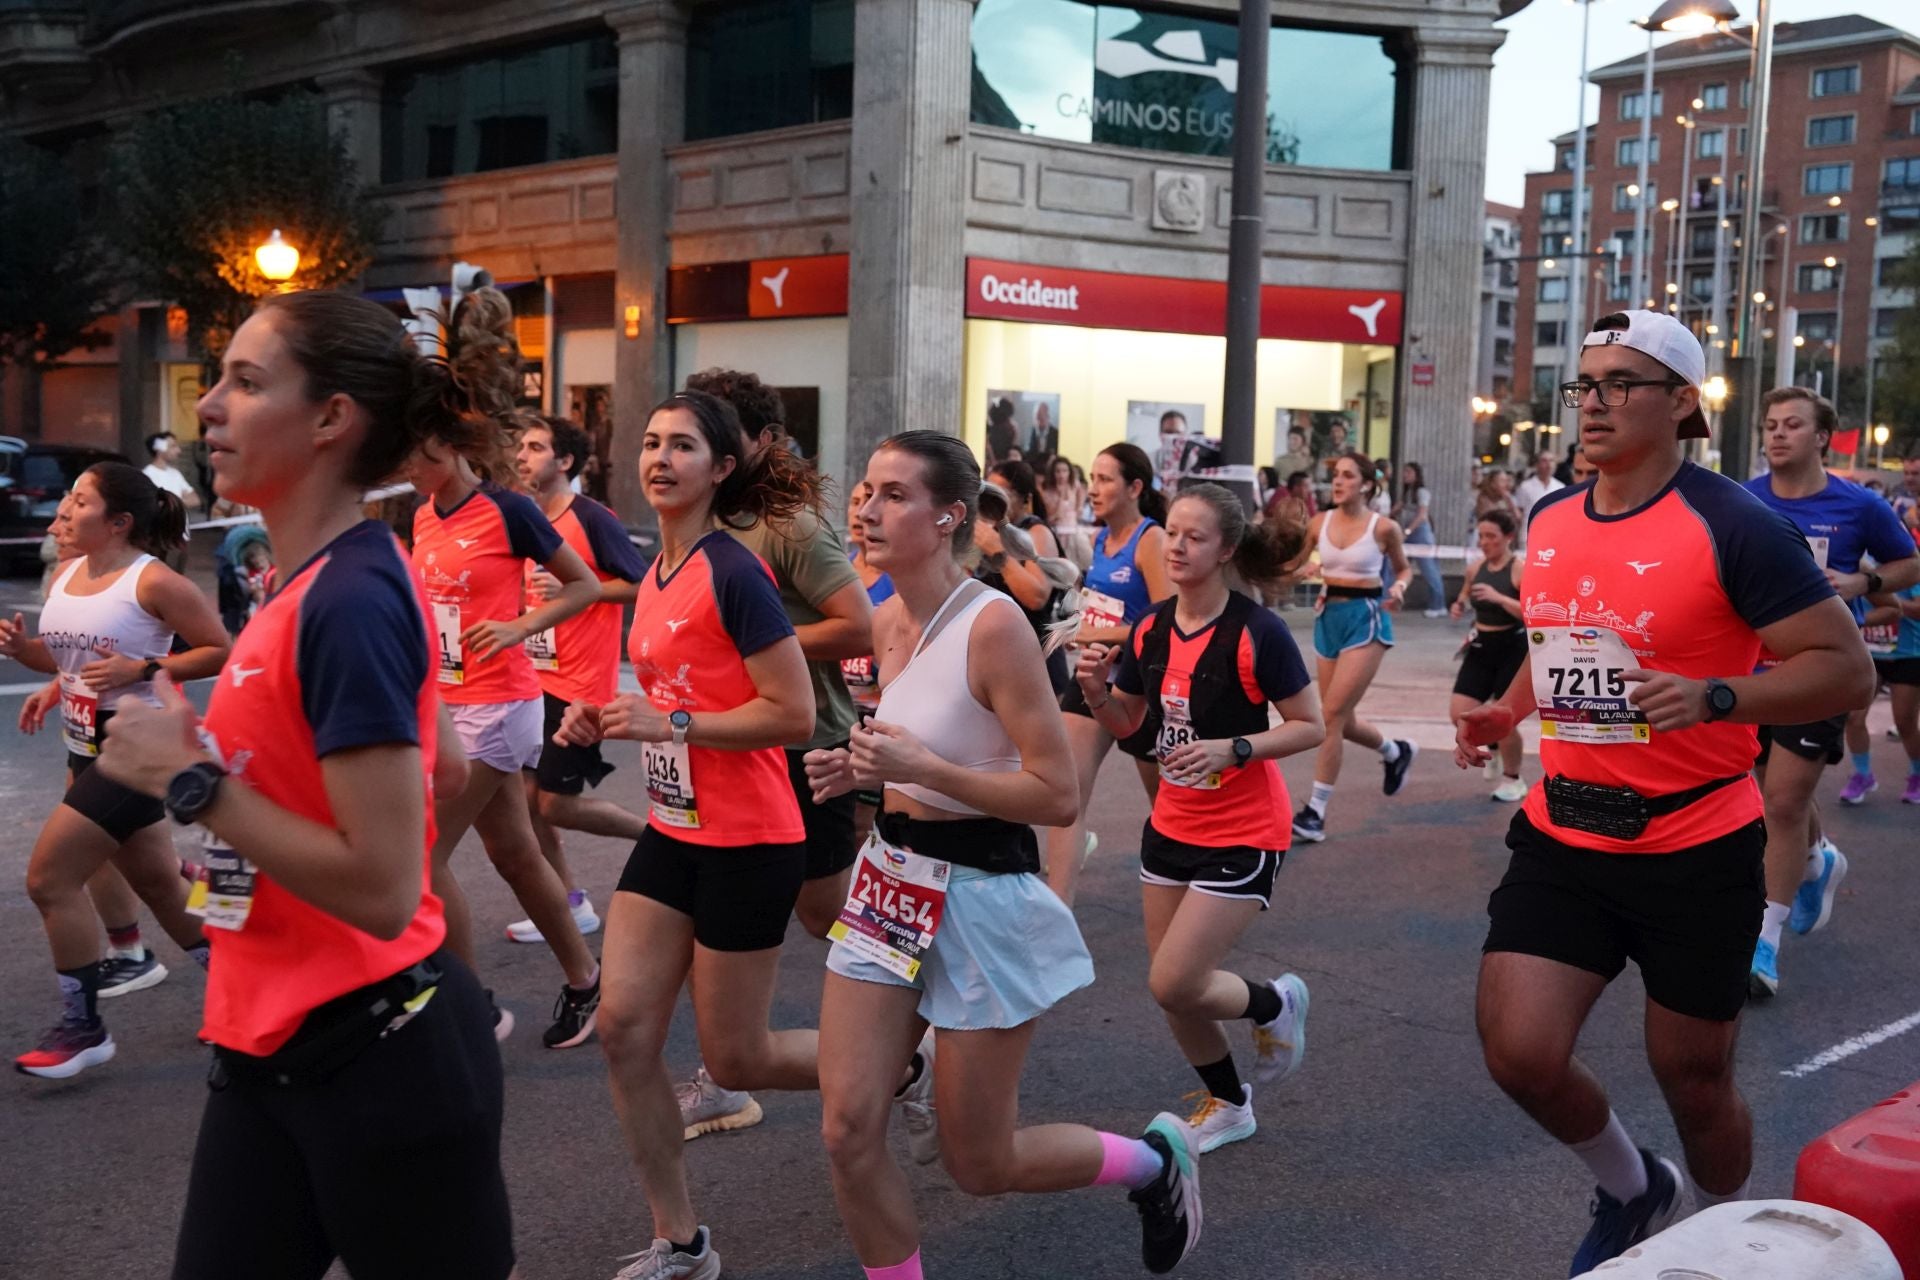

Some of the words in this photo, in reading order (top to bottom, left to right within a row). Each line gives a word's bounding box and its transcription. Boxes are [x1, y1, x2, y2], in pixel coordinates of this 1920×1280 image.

[1056, 93, 1181, 133] CAMINOS
[981, 274, 1079, 311] Occident
[1573, 656, 1596, 664] DAVID
[1548, 668, 1626, 696] 7215
[1599, 711, 1610, 719] LA
[1639, 728, 1647, 738] 5
[646, 750, 680, 783] 2436
[882, 875, 900, 887] HEAD
[857, 872, 934, 931] 21454
